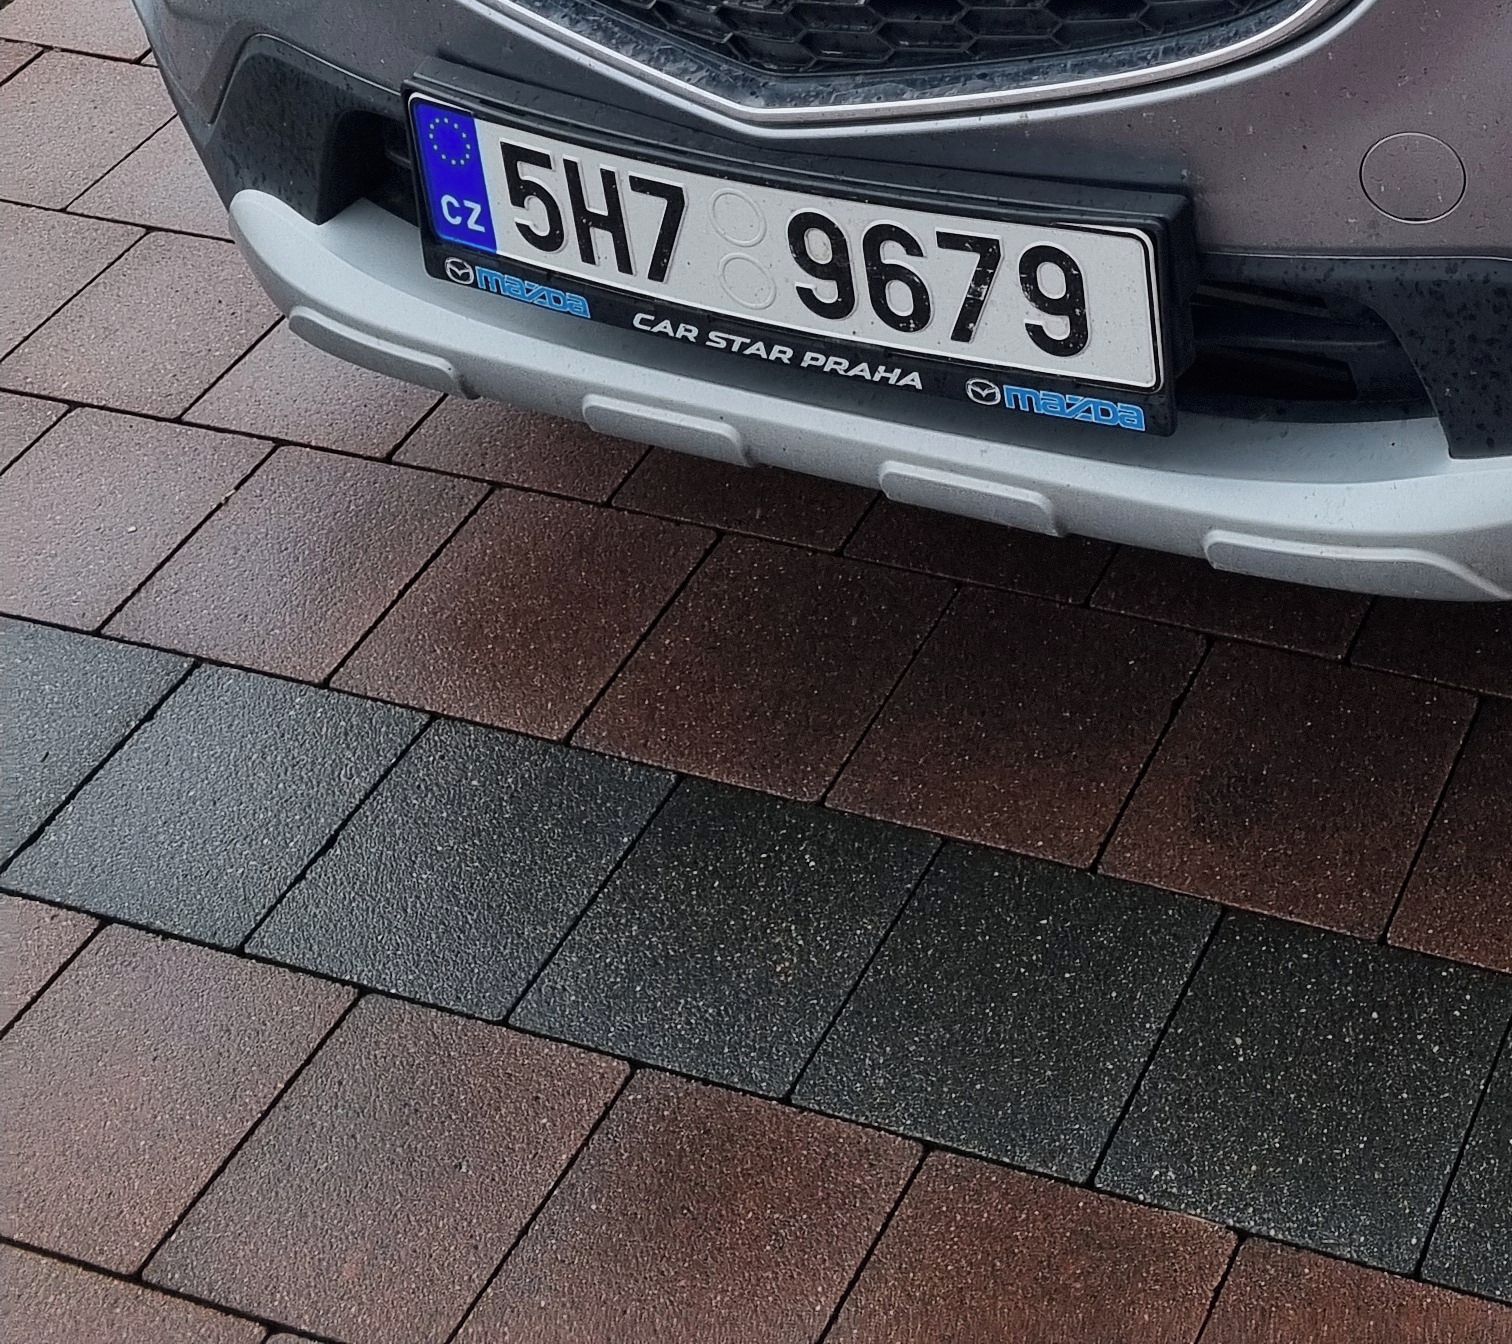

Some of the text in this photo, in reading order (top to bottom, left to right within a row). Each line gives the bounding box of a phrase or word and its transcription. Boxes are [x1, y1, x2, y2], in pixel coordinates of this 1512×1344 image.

[440, 194, 486, 233] CZ
[500, 141, 1090, 357] 5H7 9679
[632, 312, 699, 344] CAR
[705, 330, 793, 365] STAR
[800, 350, 923, 391] PRAHA
